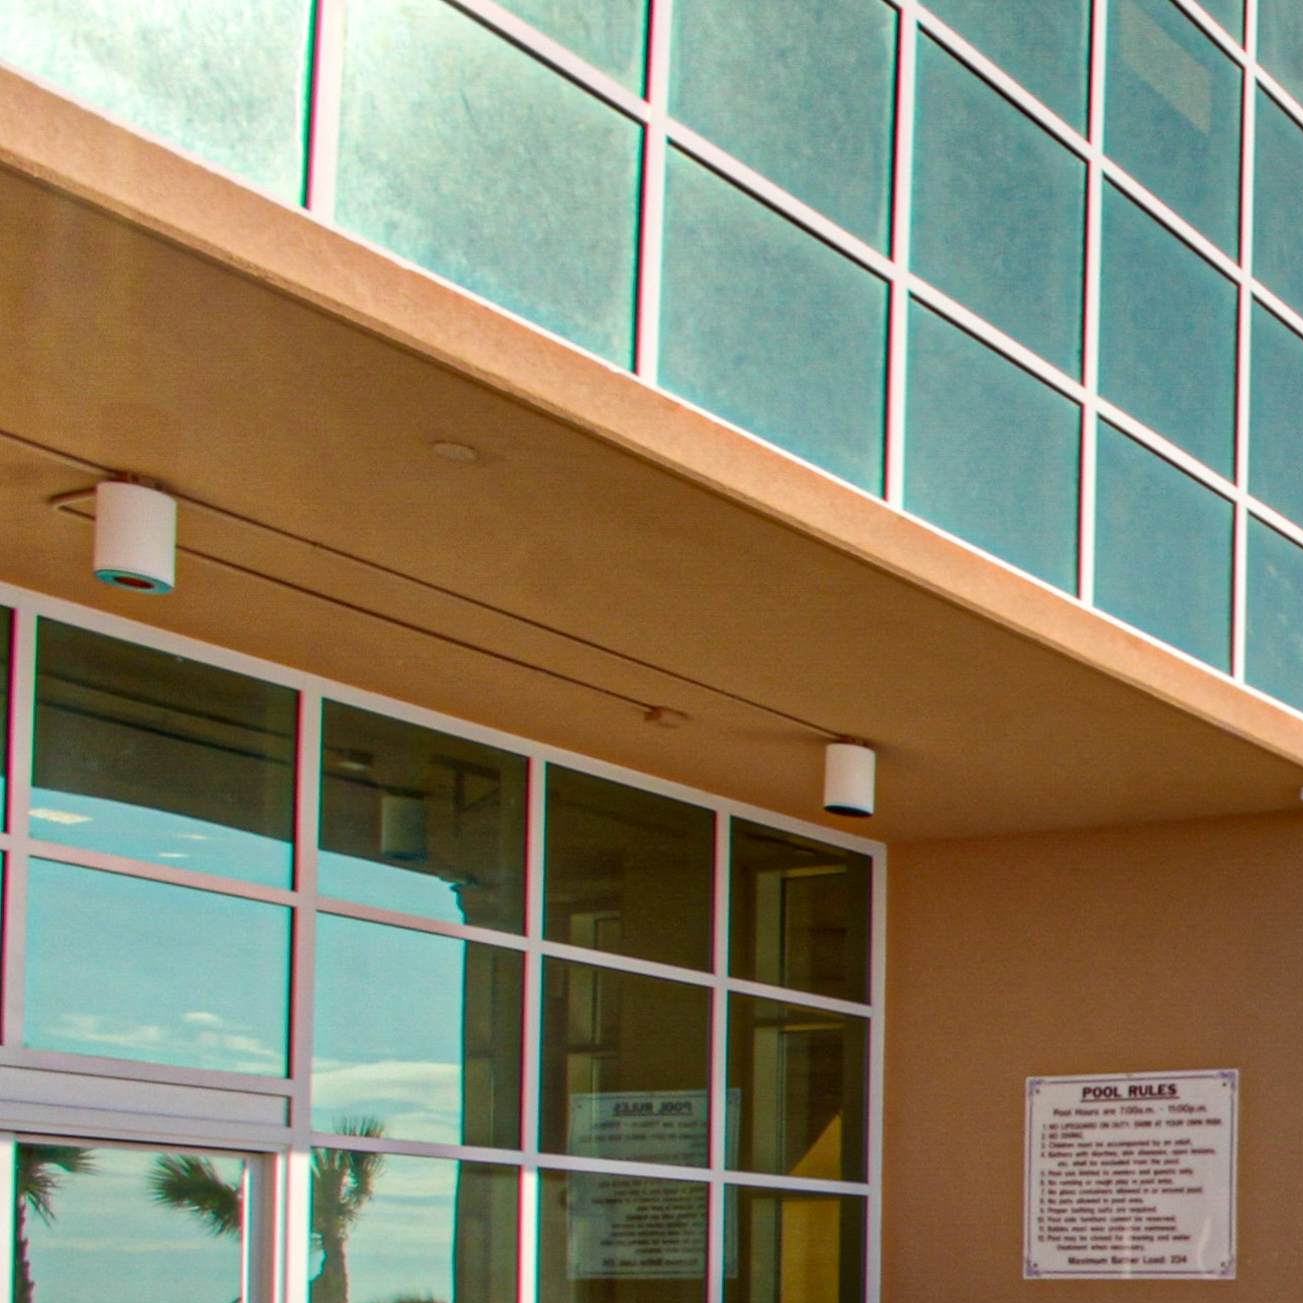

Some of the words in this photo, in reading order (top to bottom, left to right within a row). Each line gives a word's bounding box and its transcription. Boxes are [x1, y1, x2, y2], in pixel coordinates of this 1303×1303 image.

[1082, 1086, 1122, 1098] POOL
[1128, 1083, 1177, 1096] RULES
[1067, 1256, 1108, 1265] Maximum
